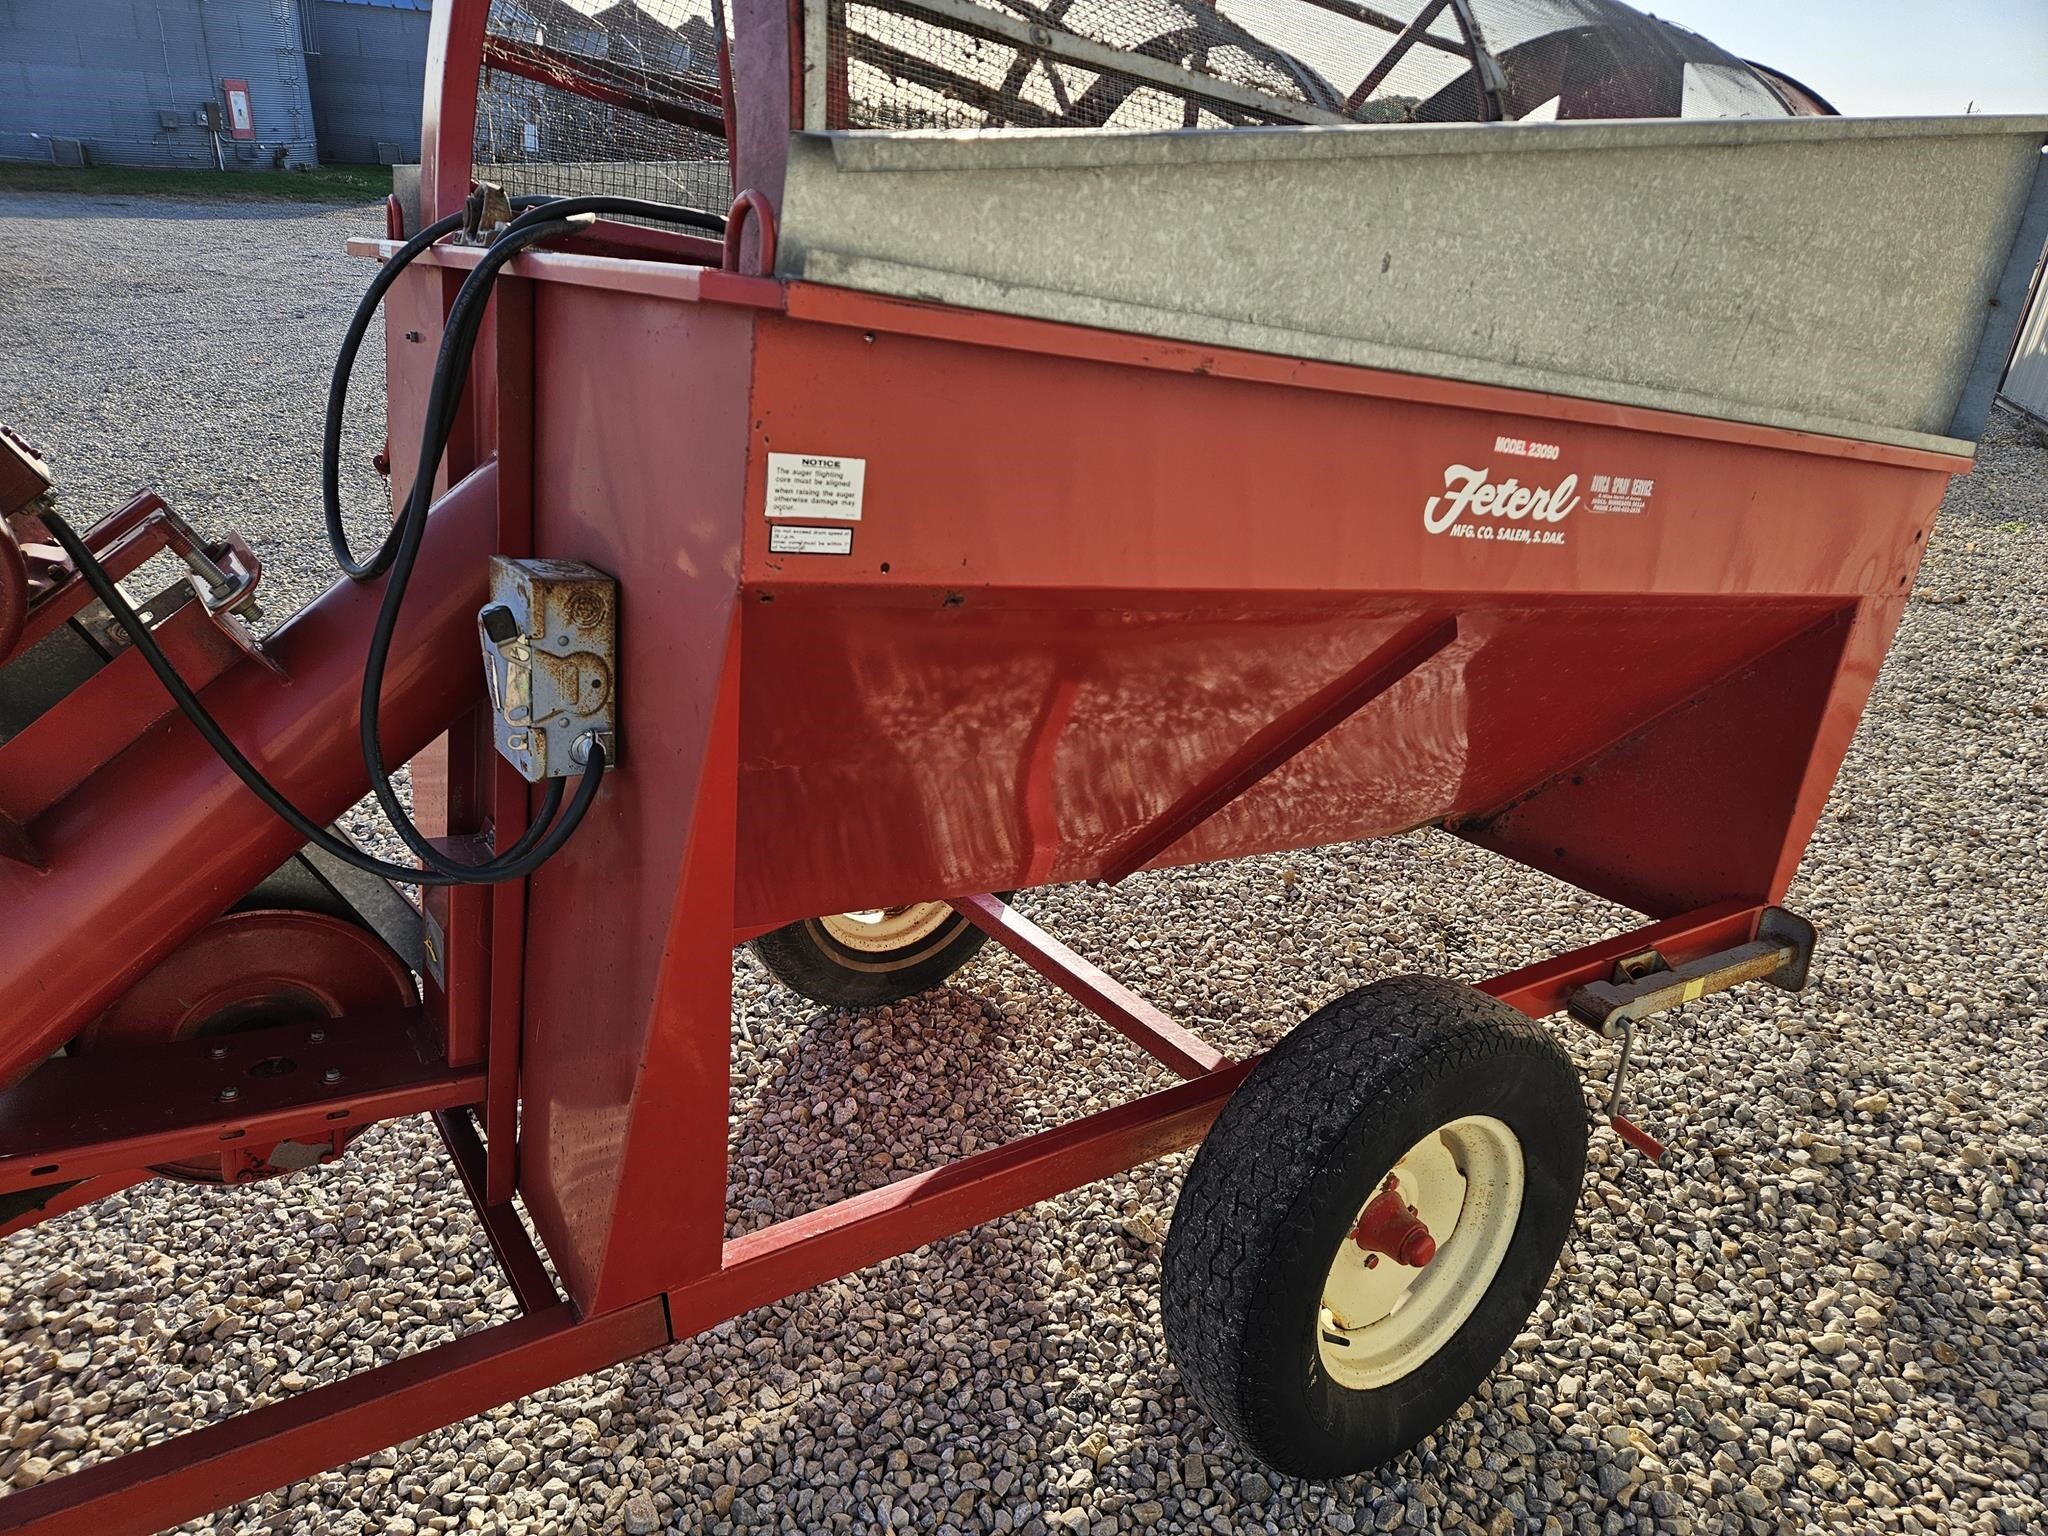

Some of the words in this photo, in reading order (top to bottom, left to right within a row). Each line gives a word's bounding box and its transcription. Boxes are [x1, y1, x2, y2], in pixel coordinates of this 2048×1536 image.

[1494, 436, 1527, 455] MODEL
[1527, 442, 1560, 460] 23090
[802, 459, 841, 468] NOTICE
[777, 466, 790, 474] The
[815, 470, 844, 480] flighting
[826, 480, 851, 488] aligned
[1611, 476, 1632, 495] SPRAY
[1631, 478, 1654, 497] SERVICE
[796, 489, 820, 498] raising
[1424, 464, 1581, 534] Feterl
[811, 498, 838, 506] damage
[1450, 524, 1476, 538] MFG.
[1477, 526, 1494, 539] CO.
[1496, 527, 1531, 544] SALEM,
[1532, 530, 1541, 543] S.
[1542, 531, 1565, 545] DAK.
